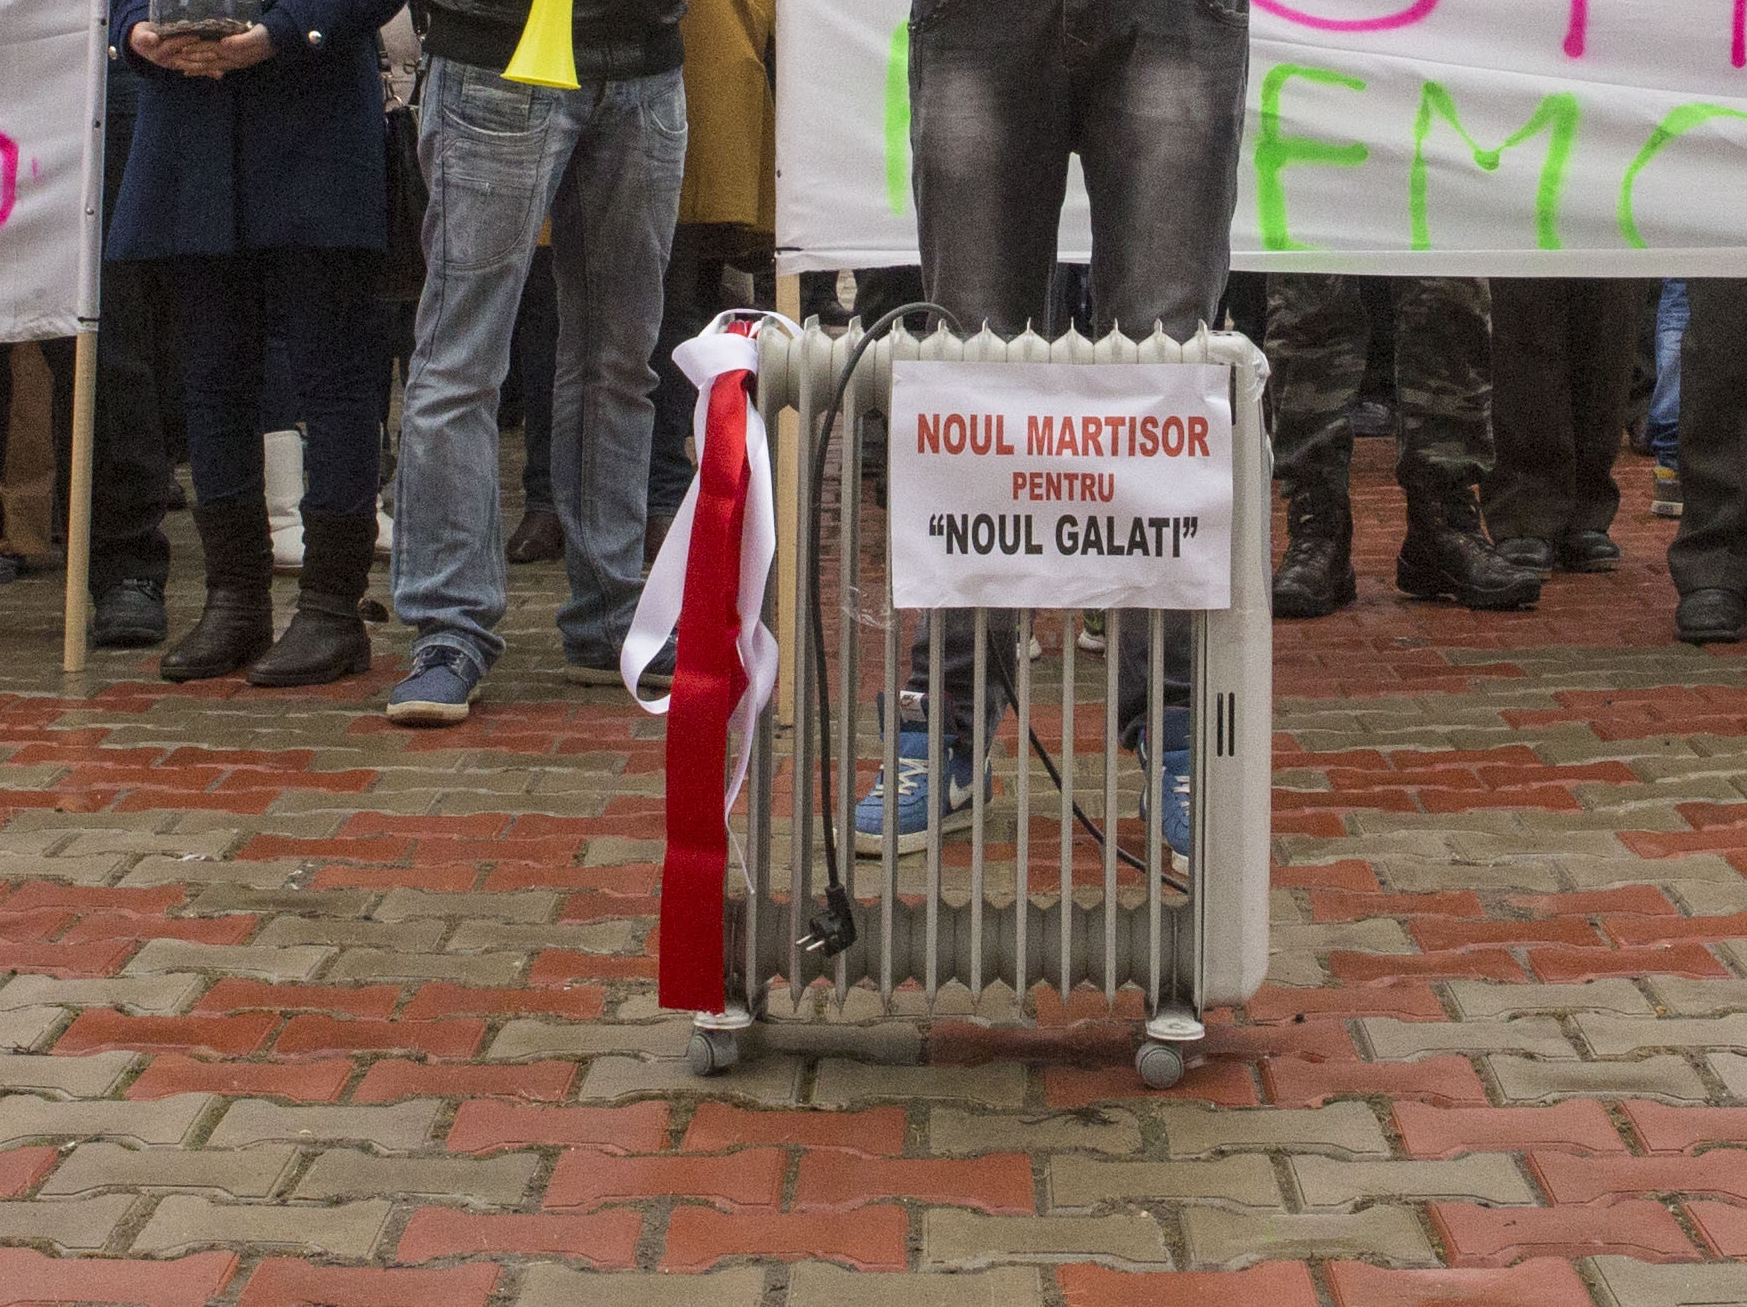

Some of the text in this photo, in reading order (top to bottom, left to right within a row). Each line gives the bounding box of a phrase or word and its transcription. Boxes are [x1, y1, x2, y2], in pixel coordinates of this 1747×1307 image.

[916, 412, 1211, 458] NOUL MARTISOR
[1012, 471, 1115, 503] PENTRU
